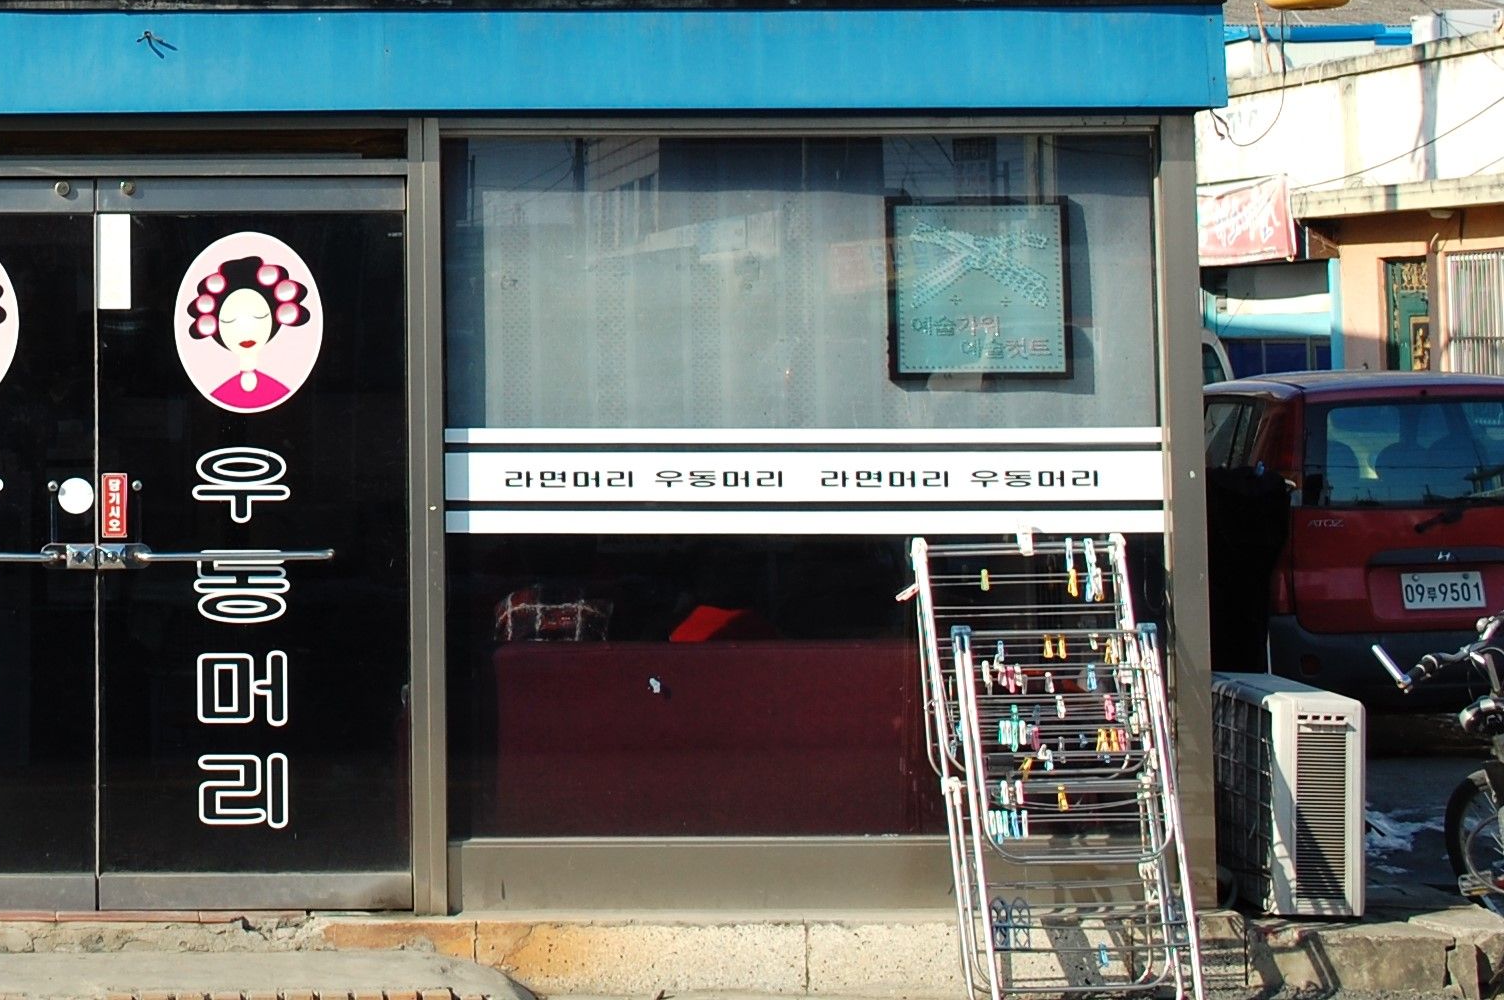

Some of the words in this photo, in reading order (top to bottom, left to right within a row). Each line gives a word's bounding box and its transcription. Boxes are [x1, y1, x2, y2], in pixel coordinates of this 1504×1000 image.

[505, 469, 634, 489] 라면머리
[655, 469, 784, 489] 우동머리
[821, 469, 949, 489] 라면머리
[971, 469, 1099, 489] 우동머리
[1404, 581, 1482, 604] 09루9501
[192, 446, 291, 829] 우동머리
